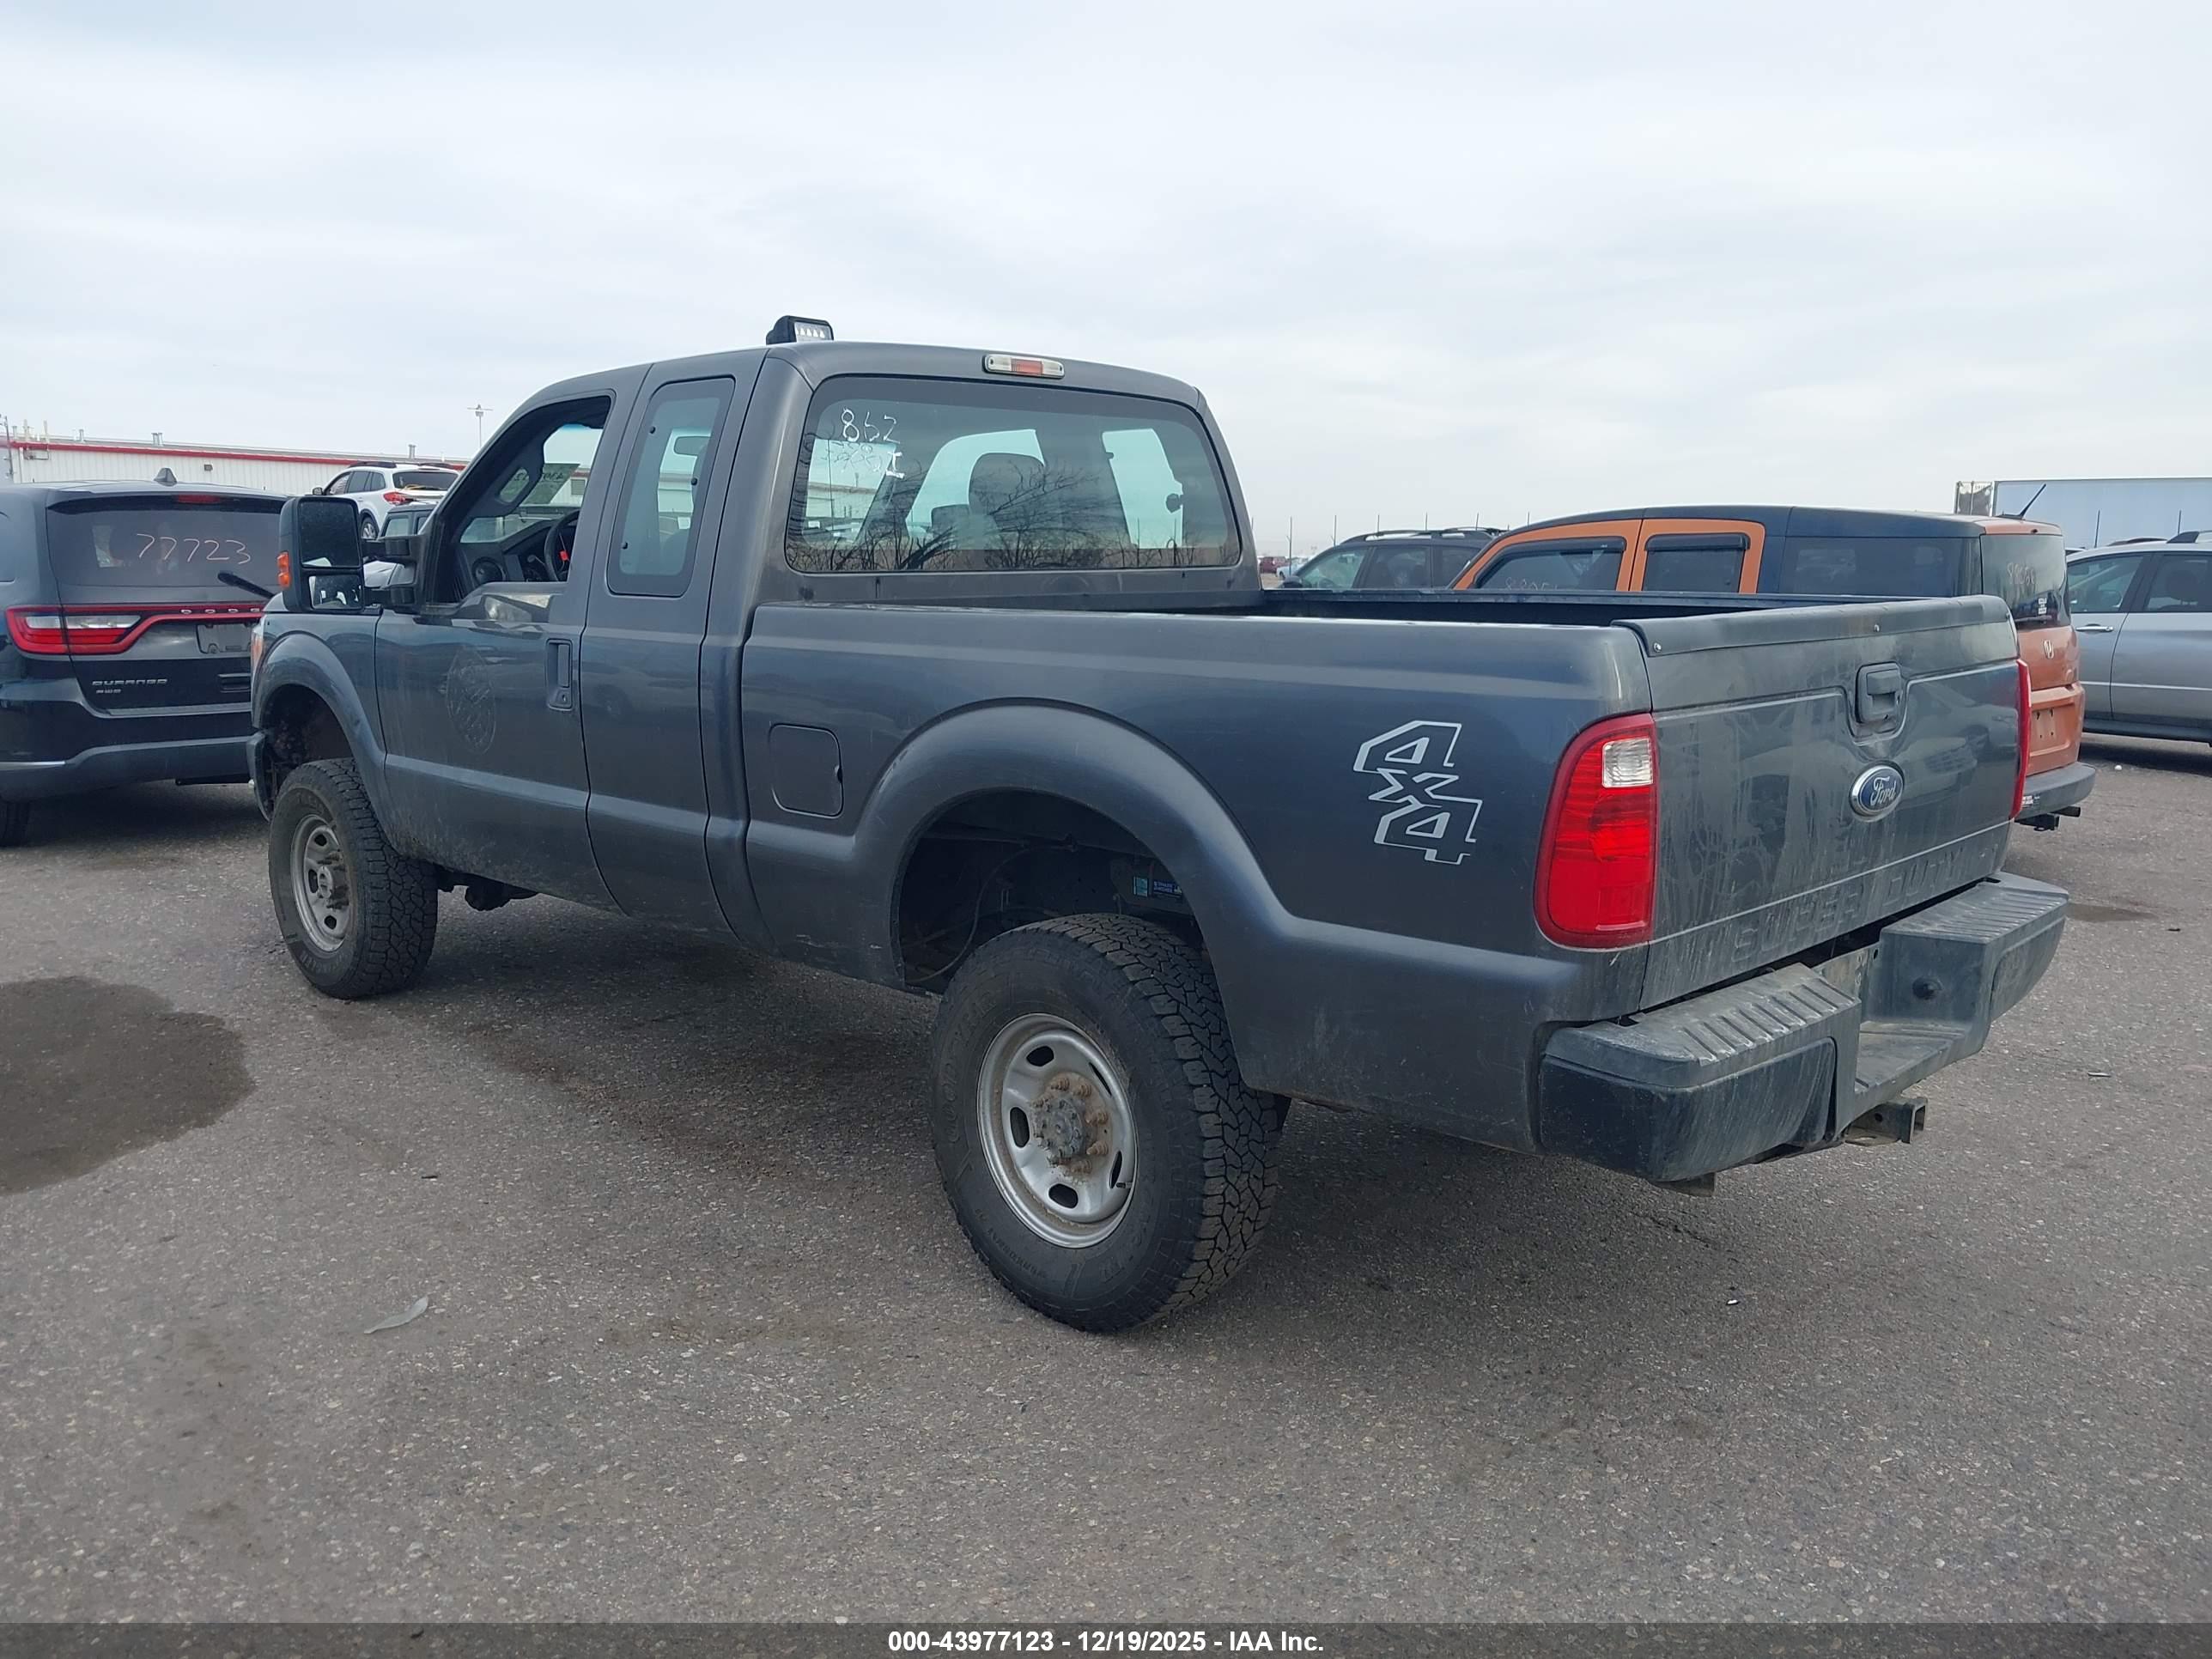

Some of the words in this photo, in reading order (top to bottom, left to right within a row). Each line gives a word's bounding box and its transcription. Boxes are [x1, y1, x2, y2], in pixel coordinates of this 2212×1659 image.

[137, 533, 251, 564] 77723
[1869, 775, 1897, 806] Ford
[1732, 884, 1865, 963] SUPER
